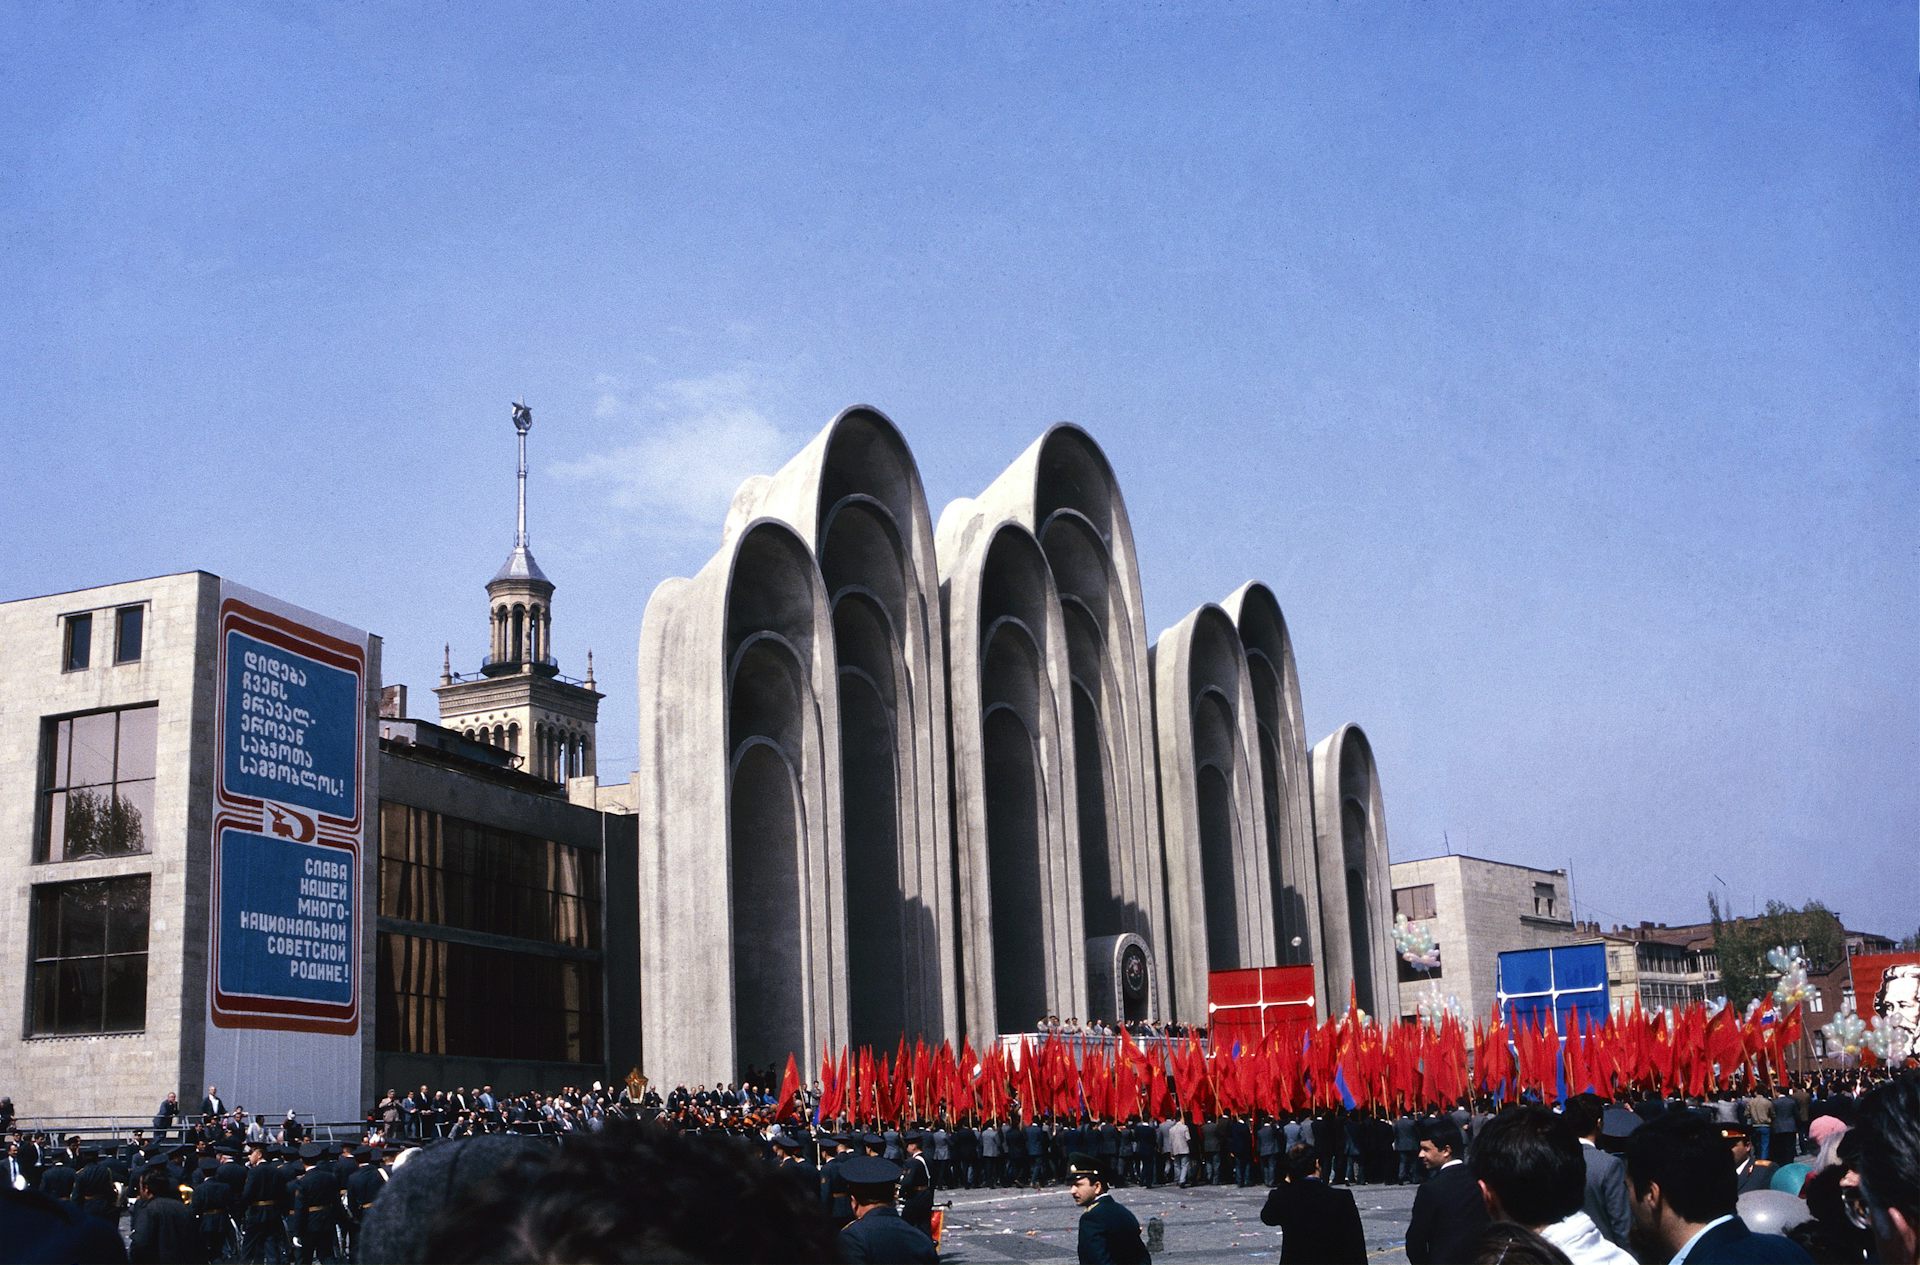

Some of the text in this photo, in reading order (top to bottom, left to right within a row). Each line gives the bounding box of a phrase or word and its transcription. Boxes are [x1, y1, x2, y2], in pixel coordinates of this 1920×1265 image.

[244, 651, 307, 687] დიდება
[242, 671, 288, 700] ჩვენს
[241, 714, 304, 745] ეროვან
[240, 735, 313, 769] საბჭოთა
[239, 755, 344, 798] სამშობლოს!
[305, 858, 348, 880] СЛАВА
[300, 878, 347, 900] НАШЕЙ
[298, 898, 349, 920] МНОГО-
[240, 911, 346, 941] НАЦИОНАЛЬНОЙ
[267, 936, 346, 962] СОВЕТСКОЙ
[290, 960, 349, 983] РОДИНЕ!
